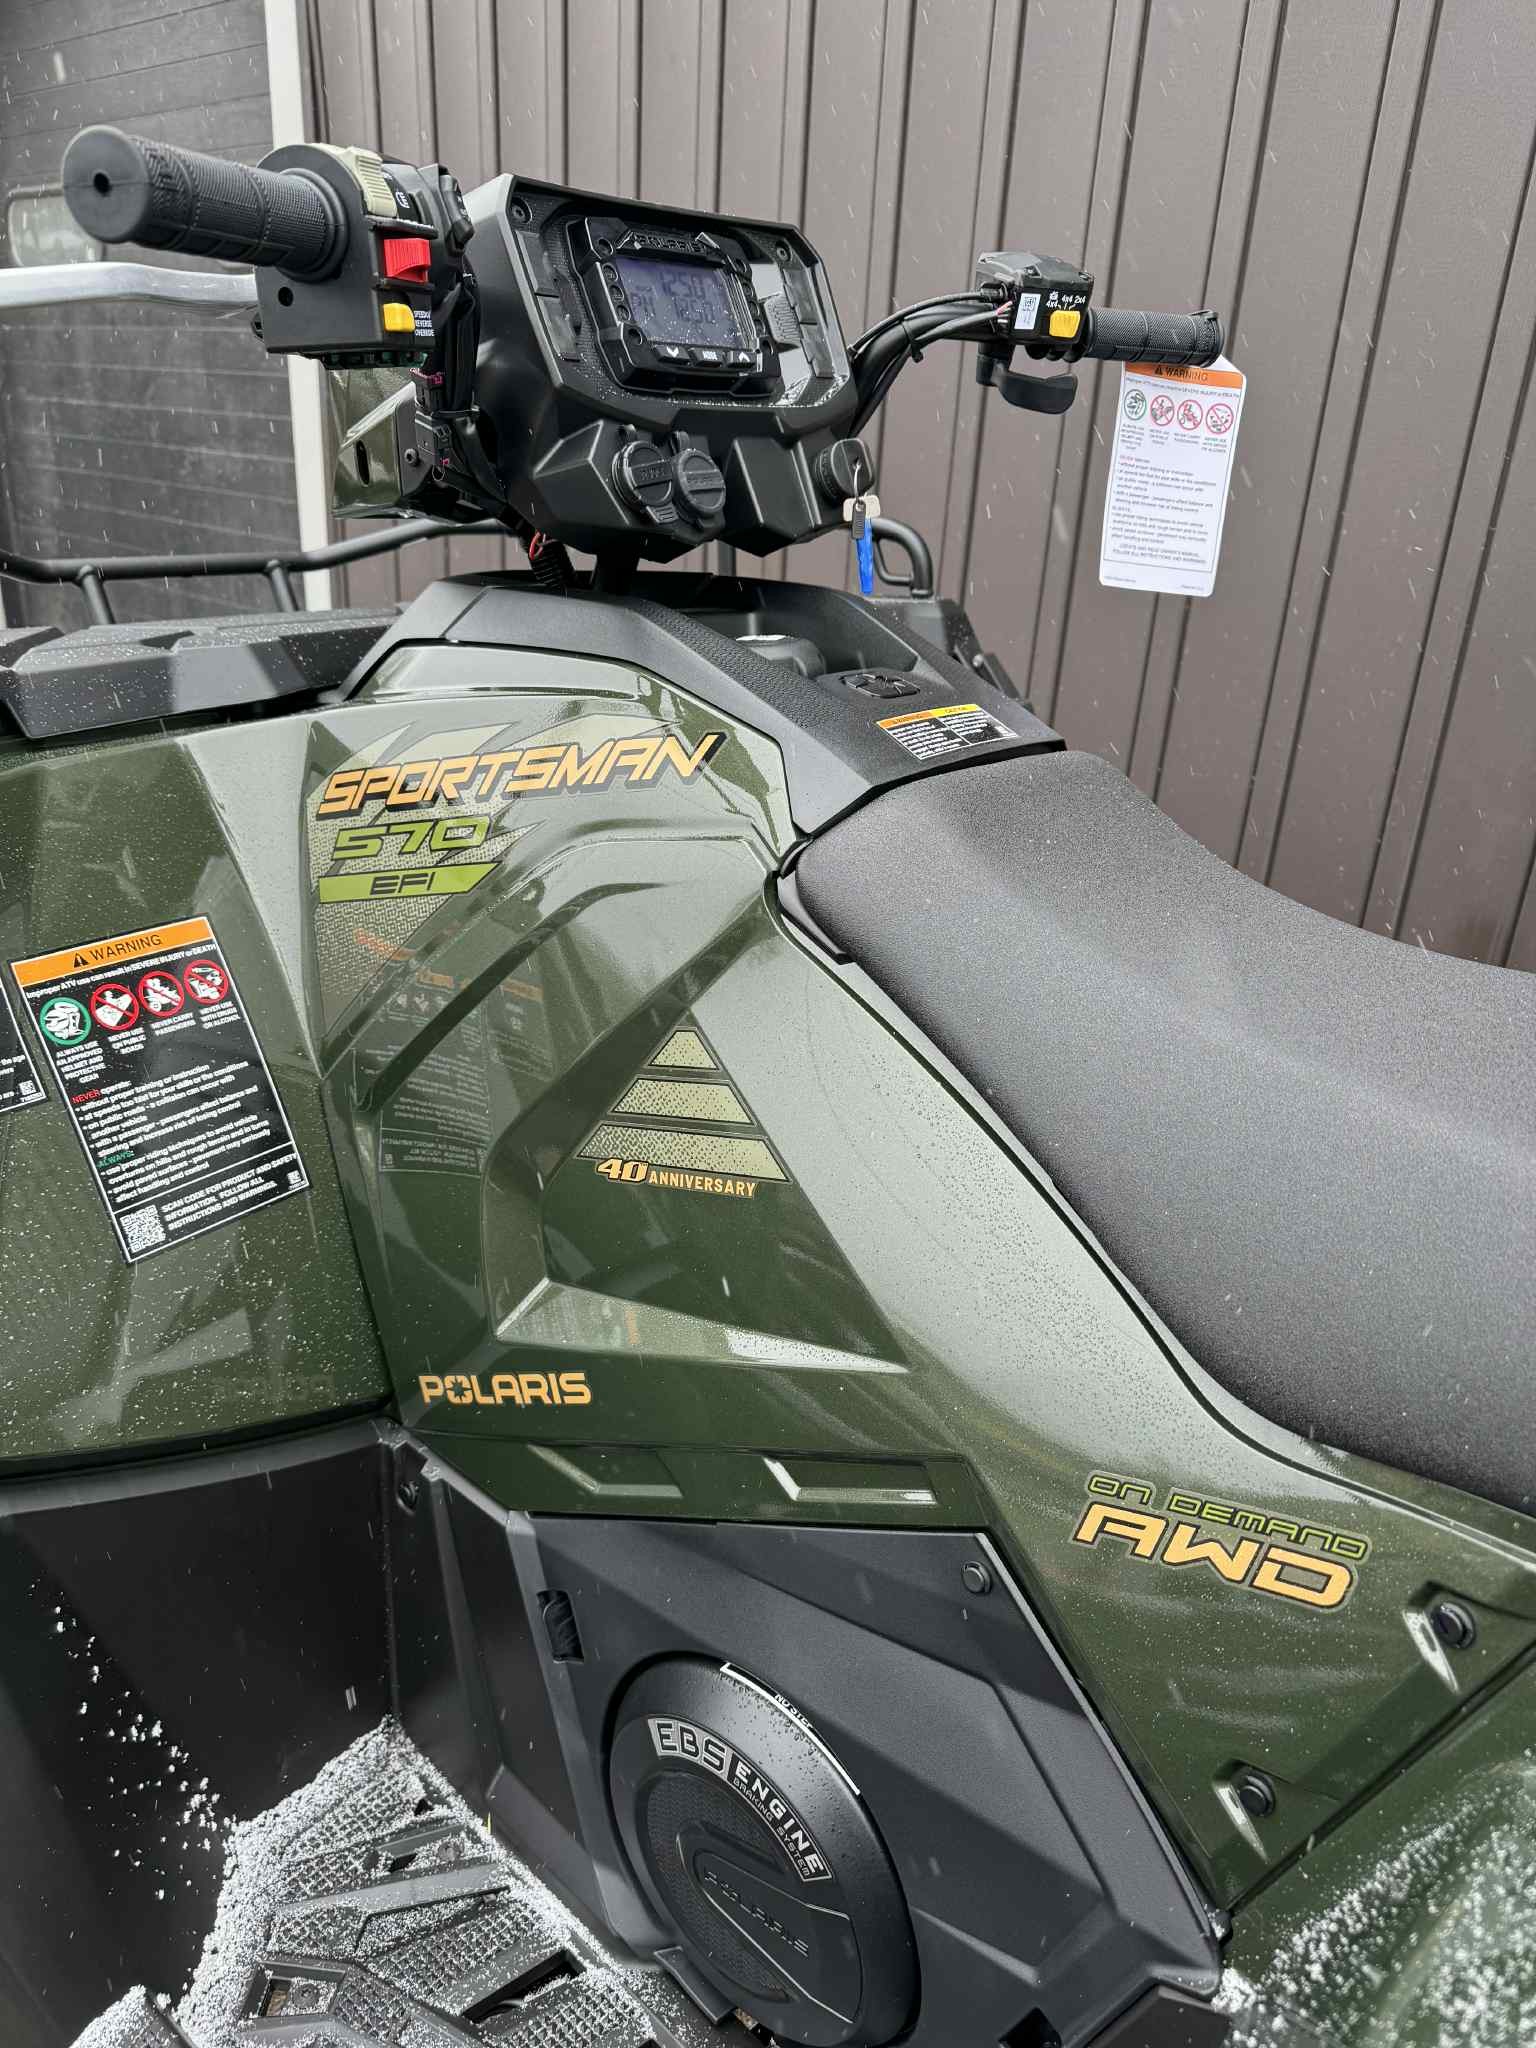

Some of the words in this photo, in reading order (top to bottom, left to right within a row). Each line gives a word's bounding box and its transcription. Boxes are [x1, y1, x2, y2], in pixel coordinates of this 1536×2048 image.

[1166, 366, 1209, 381] WARNING
[317, 732, 726, 818] SPORTSMAN
[331, 815, 492, 860] 570
[370, 871, 436, 896] EFI
[59, 978, 77, 989] ATV
[191, 942, 216, 955] DEATH
[89, 934, 163, 961] WARNING
[71, 1089, 100, 1103] NEVER
[159, 1198, 184, 1213] SCAN
[183, 1189, 206, 1204] CODE
[205, 1182, 222, 1194] FOR
[220, 1168, 256, 1188] PRODUCT
[649, 1170, 757, 1198] ANNIVERSARY
[418, 1372, 592, 1405] POLARIS
[1088, 1474, 1153, 1505] ON
[1167, 1493, 1369, 1560] DEMAND
[1073, 1501, 1354, 1608] AWD
[655, 1720, 727, 1774] EBS
[733, 1778, 774, 1822] BRAKING
[776, 1825, 811, 1877] SYSTEM
[735, 1760, 824, 1874] ENGINE
